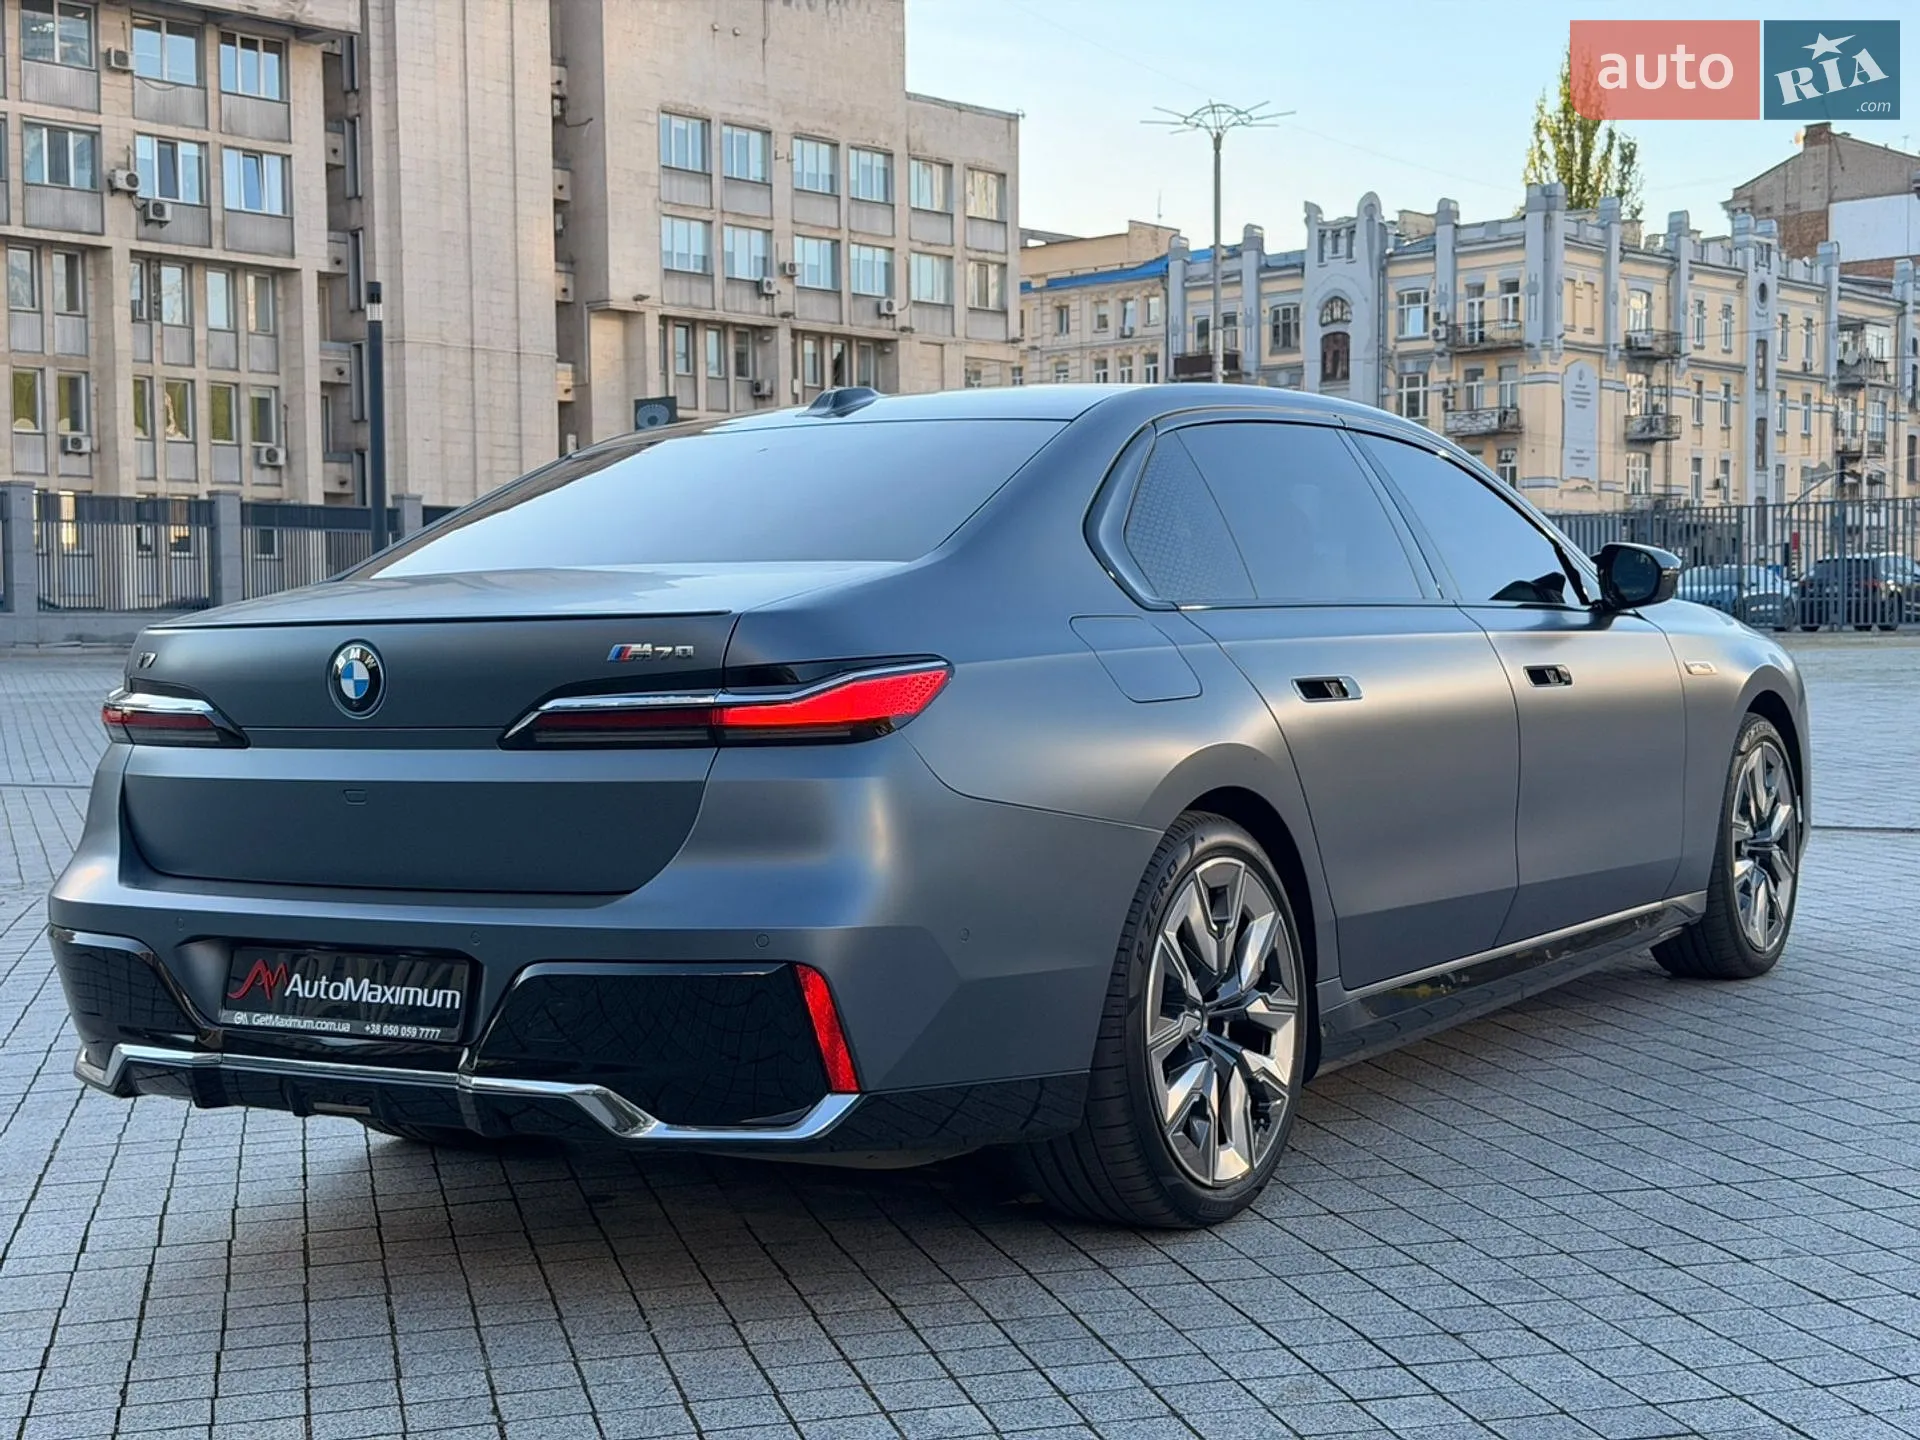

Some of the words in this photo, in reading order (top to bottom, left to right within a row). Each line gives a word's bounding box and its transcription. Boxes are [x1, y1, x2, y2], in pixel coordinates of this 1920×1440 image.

[334, 648, 377, 675] BMW
[1143, 859, 1179, 936] ZERO
[284, 973, 461, 1009] AutoMaximum
[251, 1013, 351, 1032] GetMaximum.com.ua
[364, 1024, 381, 1035] +38
[382, 1025, 399, 1036] 050
[400, 1027, 417, 1038] 059
[418, 1027, 441, 1040] 7777
